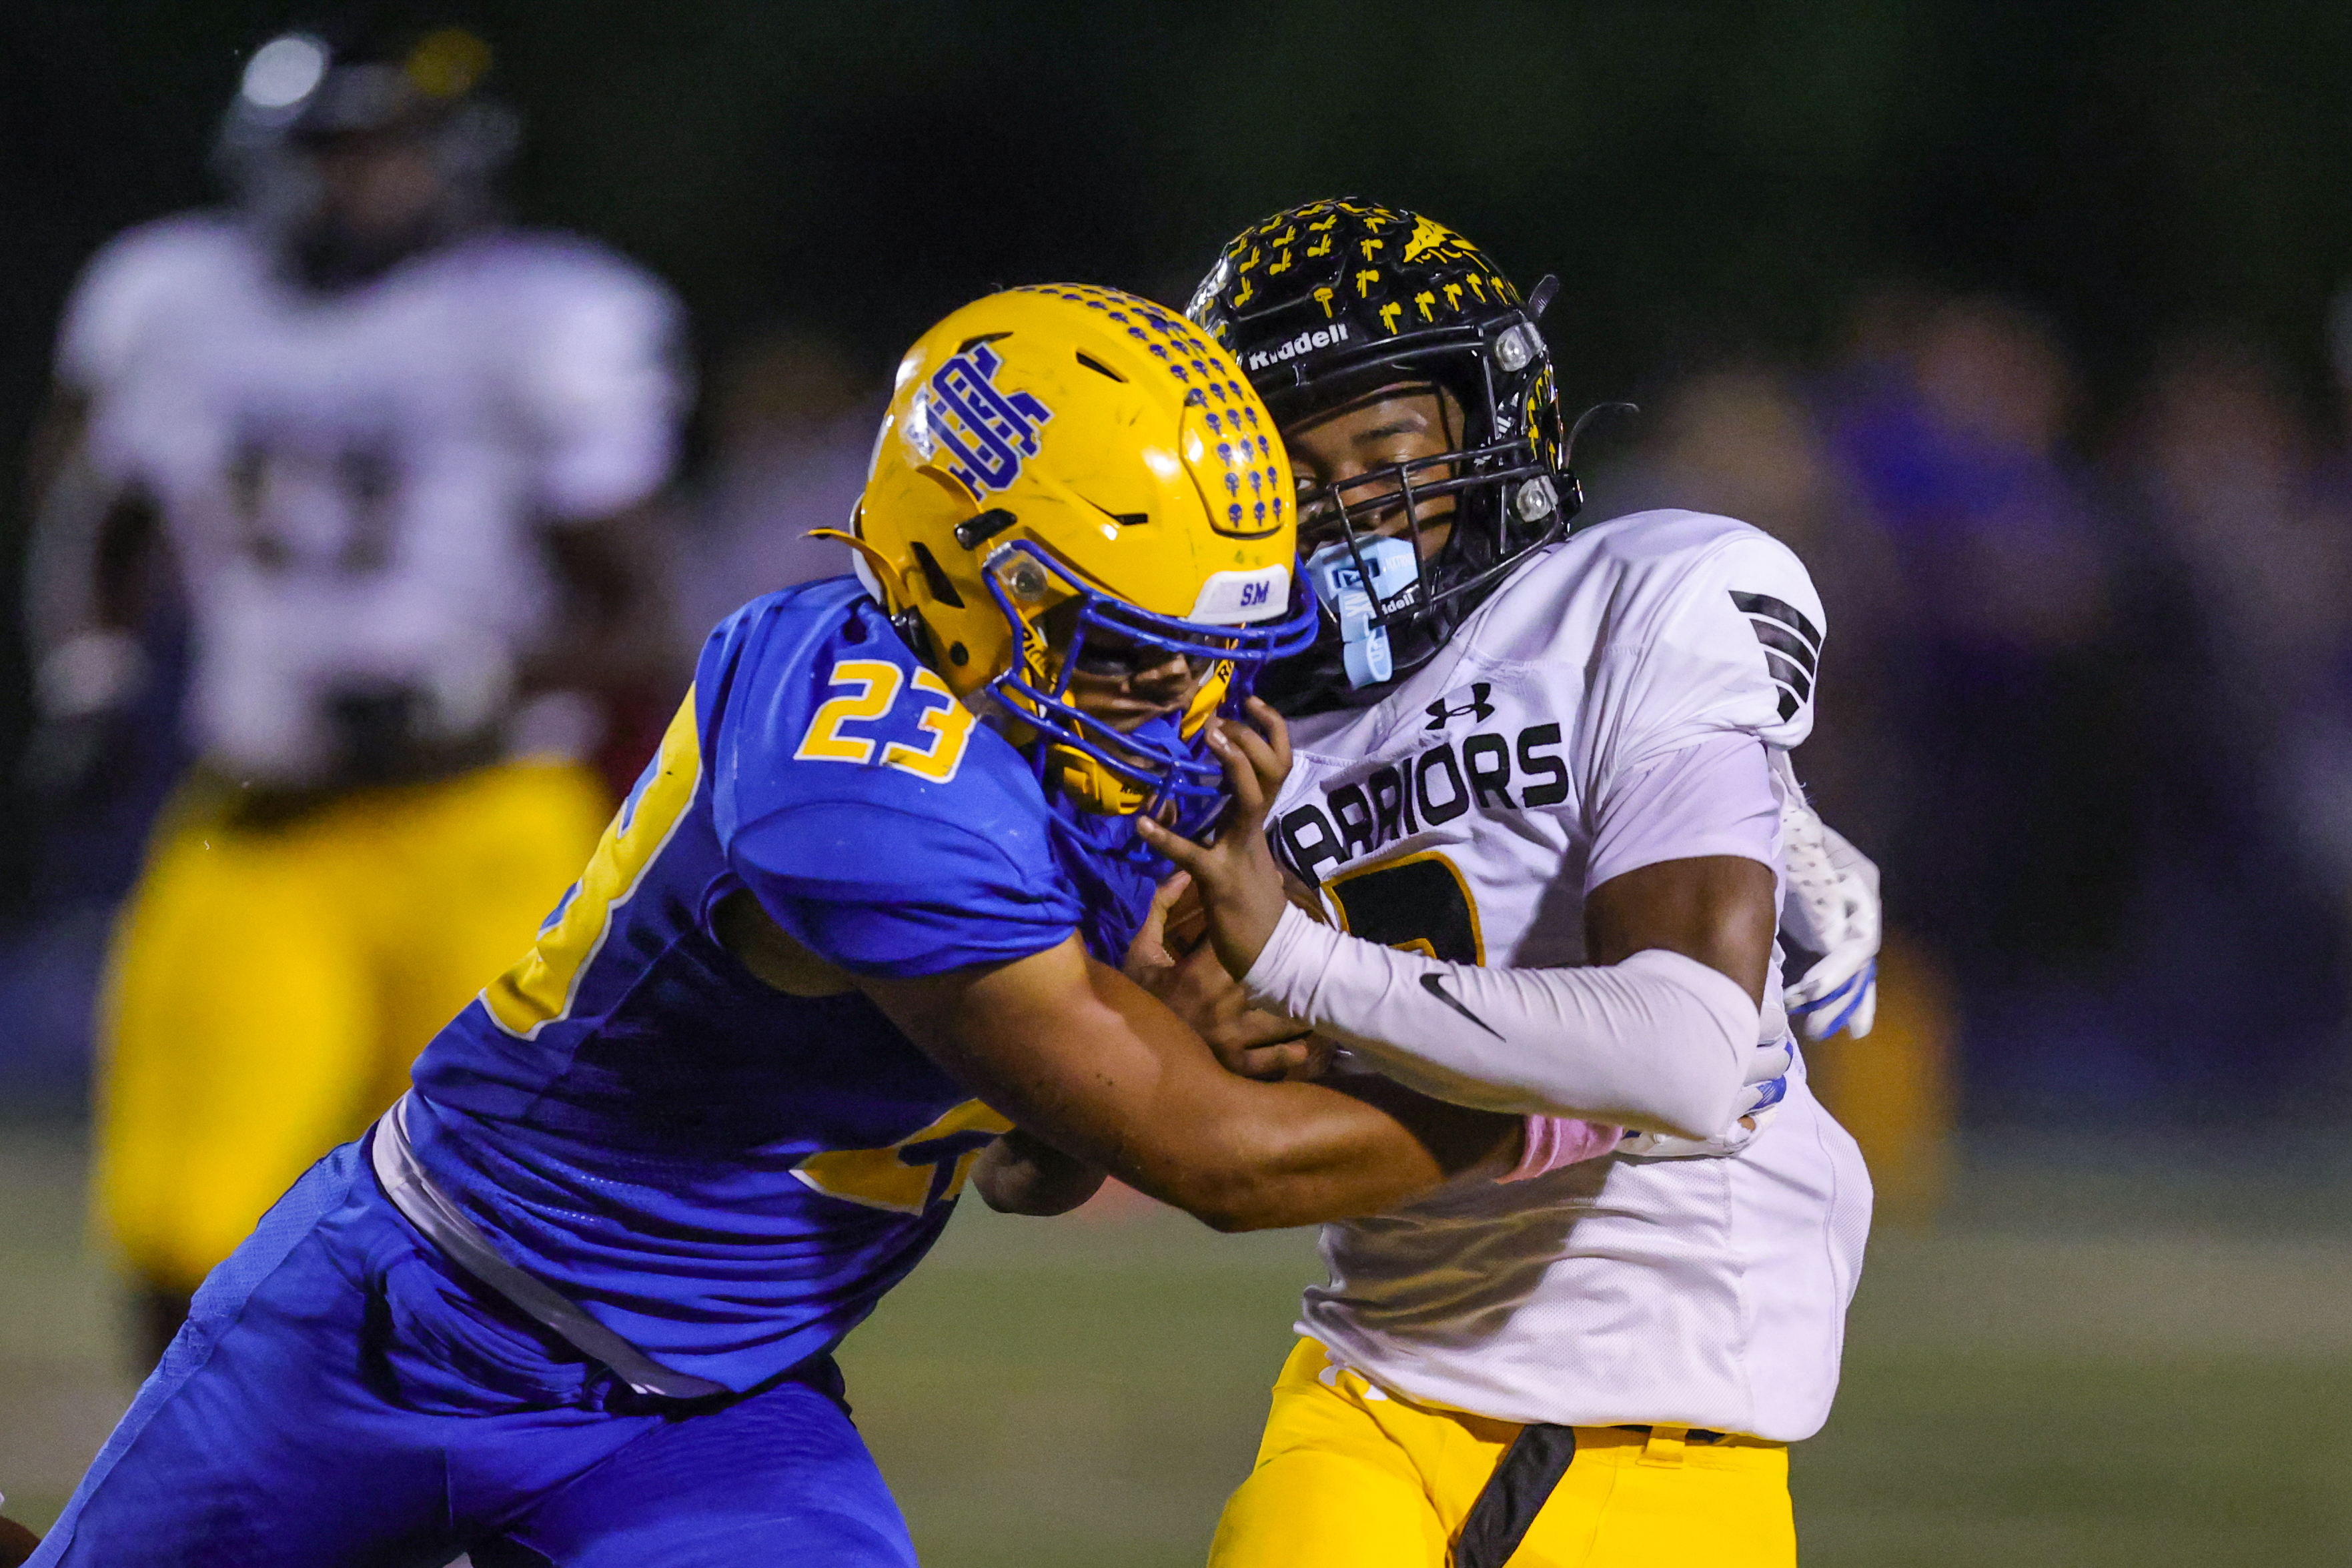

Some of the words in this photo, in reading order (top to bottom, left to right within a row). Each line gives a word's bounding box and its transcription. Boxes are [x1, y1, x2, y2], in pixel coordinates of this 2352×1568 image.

[1241, 580, 1269, 606] SM
[794, 658, 977, 784] 23
[1266, 722, 1570, 890] ARRIORS
